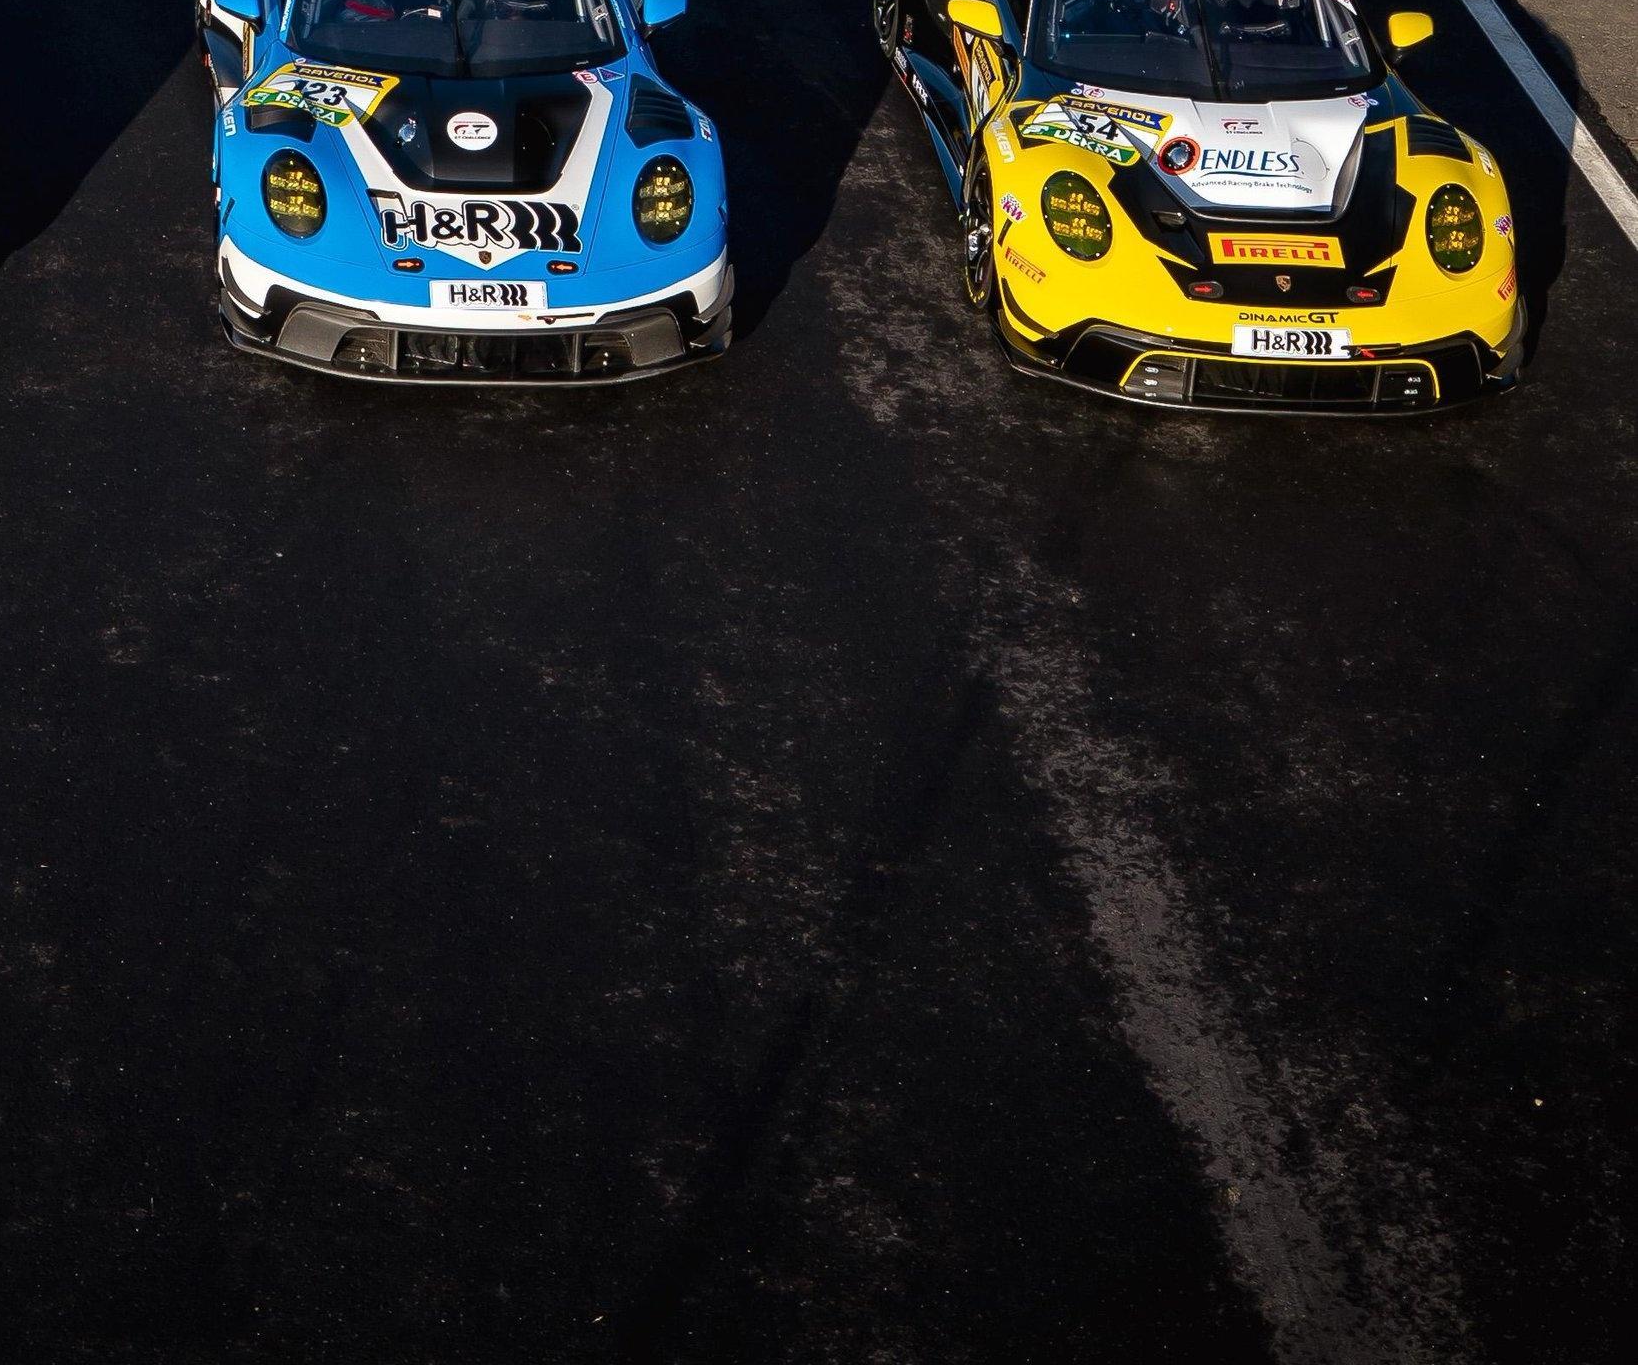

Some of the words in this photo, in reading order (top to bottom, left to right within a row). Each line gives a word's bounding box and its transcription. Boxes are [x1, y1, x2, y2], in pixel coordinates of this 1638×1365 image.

[299, 67, 380, 86] RAVENOL
[1071, 98, 1157, 126] RAVENOL
[1077, 112, 1120, 141] 54
[1052, 127, 1124, 162] DEKRA
[1200, 148, 1301, 174] ENDLESS
[1228, 180, 1253, 189] Racing
[1254, 180, 1274, 188] Brake
[1276, 182, 1314, 195] Technology
[380, 201, 514, 250] H&R
[1222, 238, 1332, 262] PIRELLI
[1003, 245, 1048, 286] PIRELLI
[449, 282, 498, 306] H&R
[1252, 328, 1301, 353] H&R
